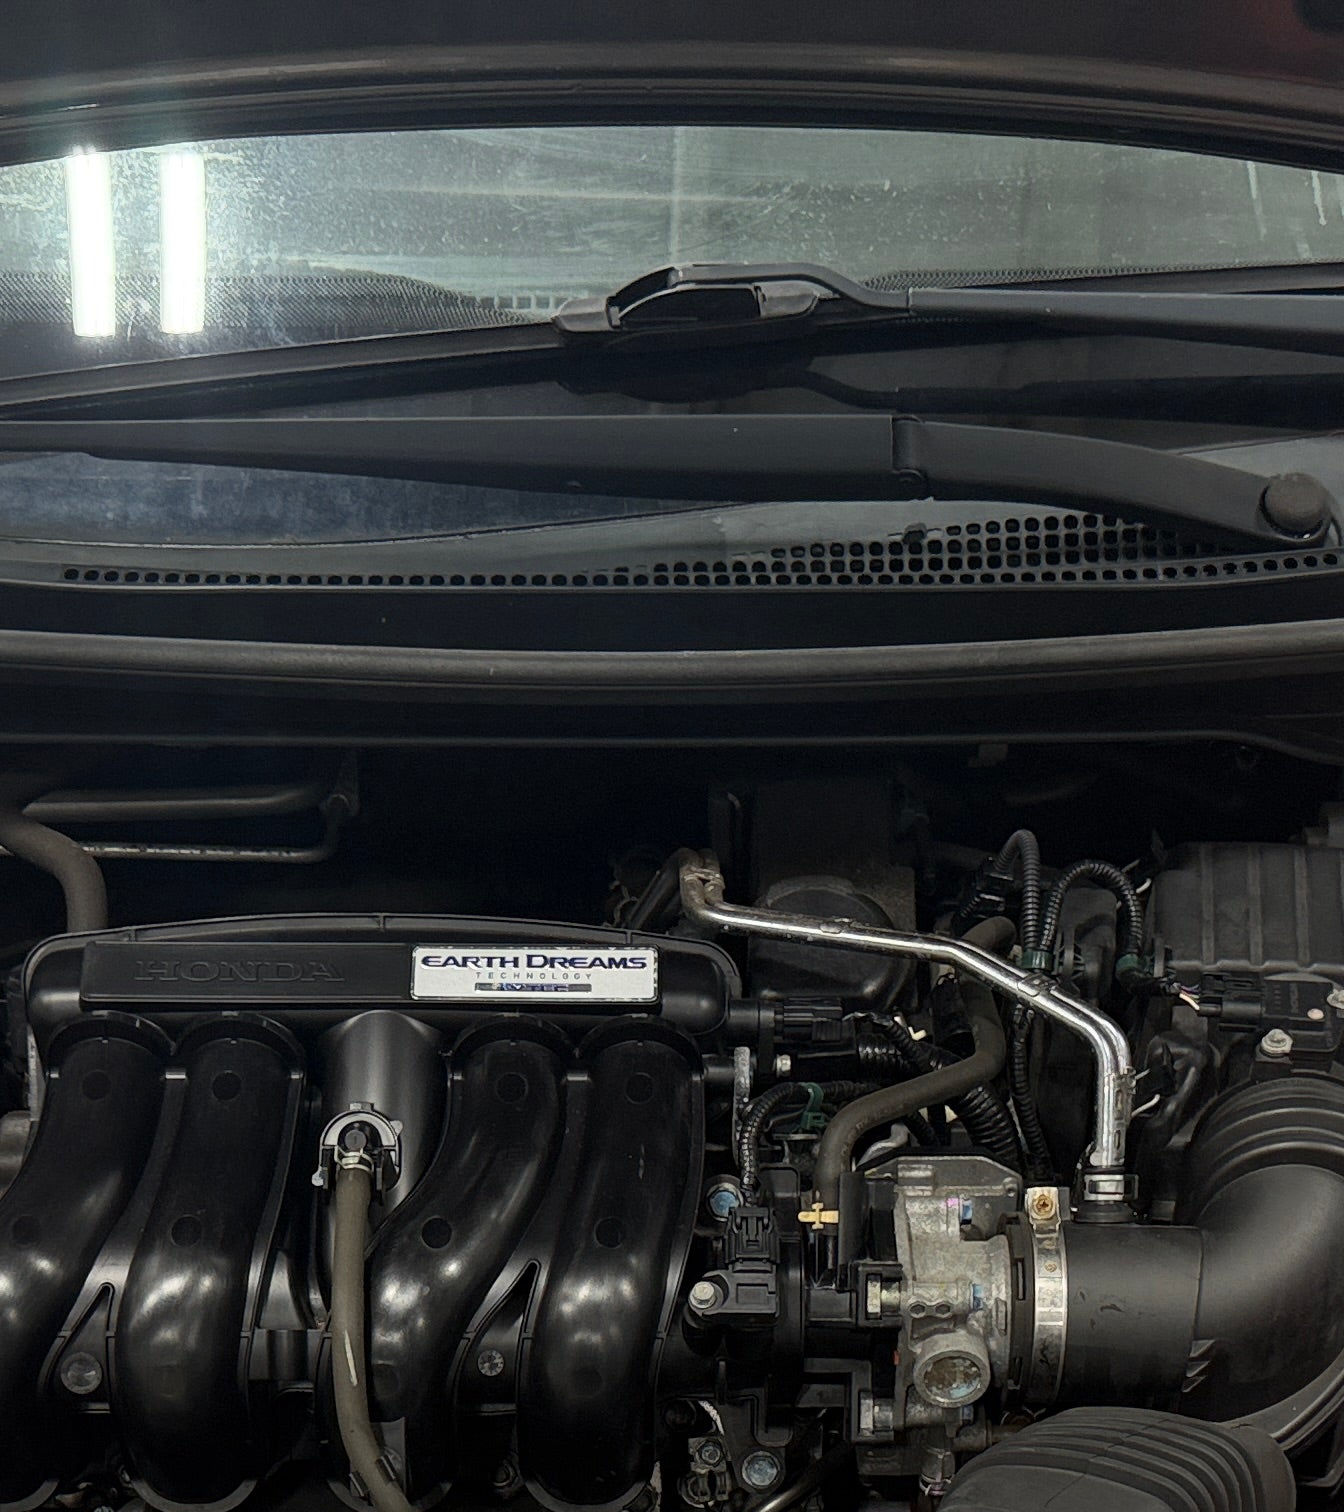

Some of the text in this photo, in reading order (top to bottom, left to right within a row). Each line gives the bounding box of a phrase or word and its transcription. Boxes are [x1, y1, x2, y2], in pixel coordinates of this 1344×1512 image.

[421, 954, 648, 969] EARTH DREAMS
[133, 960, 345, 982] HONDA
[475, 971, 592, 980] TECHNOLOGY
